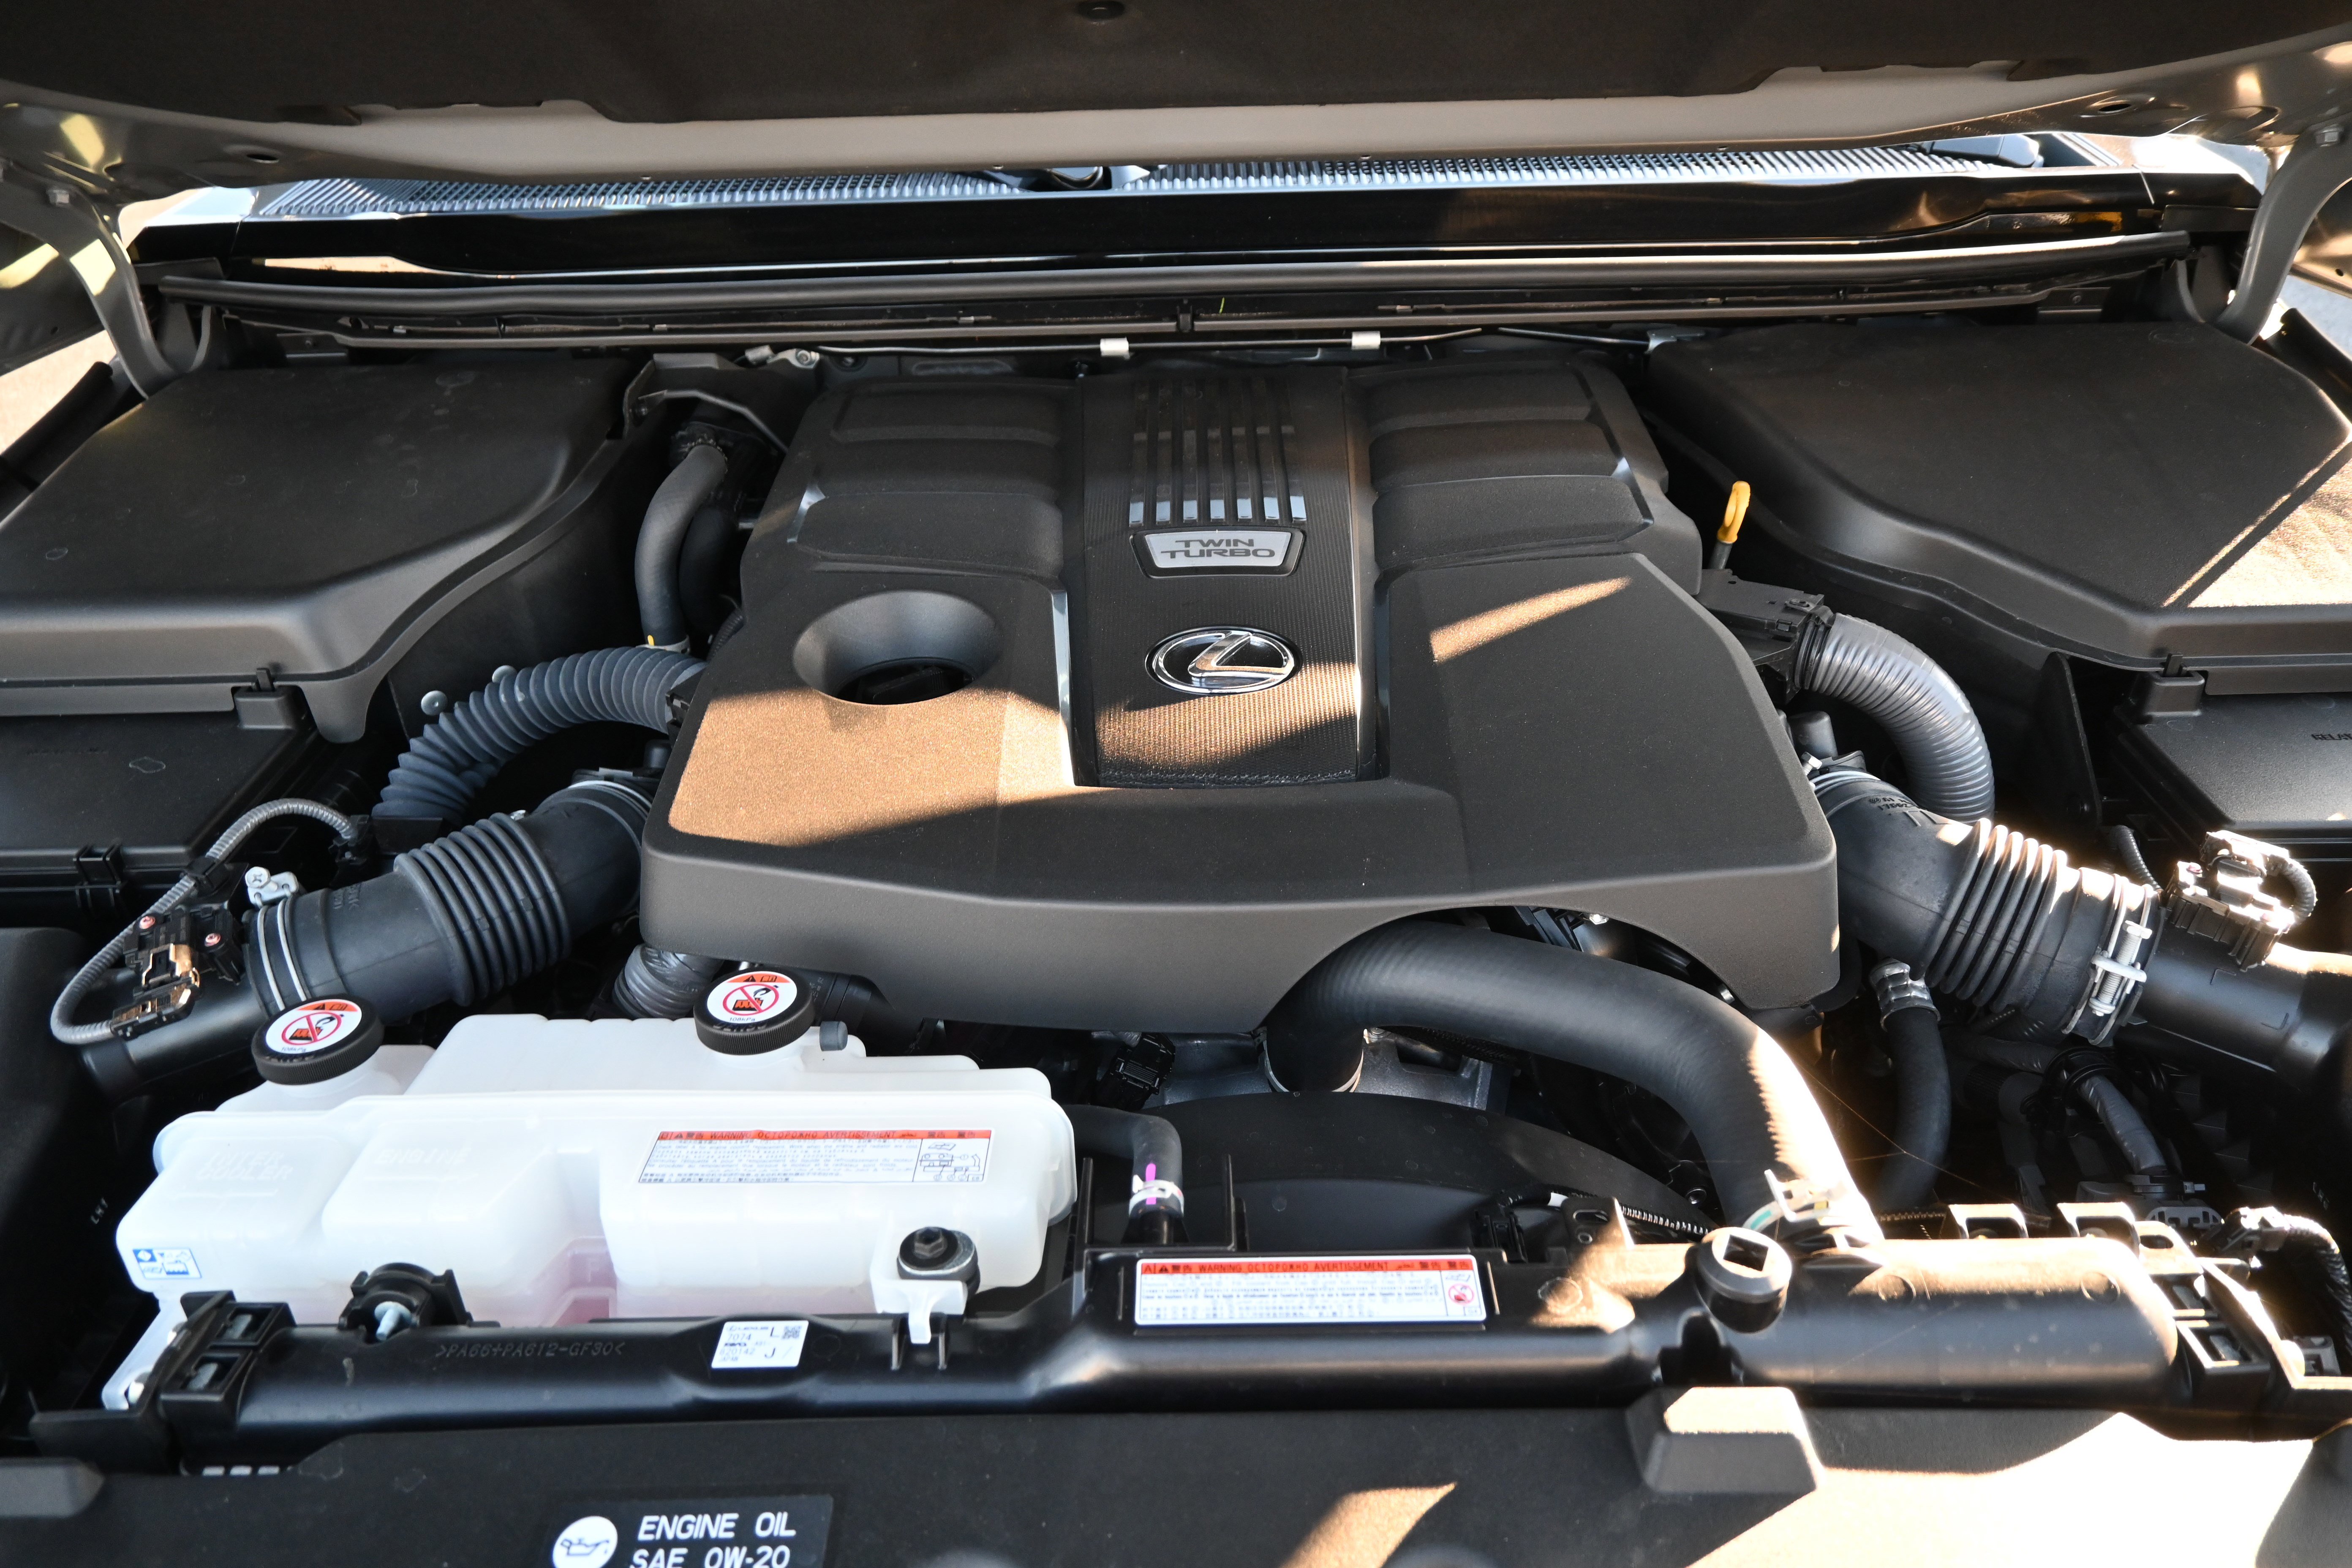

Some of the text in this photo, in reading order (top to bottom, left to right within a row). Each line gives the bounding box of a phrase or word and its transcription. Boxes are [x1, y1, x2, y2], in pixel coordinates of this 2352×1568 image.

[1175, 539, 1254, 548] TWIN
[1160, 548, 1276, 558] TURBO
[204, 1151, 285, 1166] INTER
[374, 1147, 472, 1165] ENGINE
[196, 1164, 294, 1181] COOLER
[1199, 1264, 1242, 1272] WARNING
[1314, 1262, 1388, 1271] AVERTISSEMENT
[765, 1347, 776, 1359] J
[637, 1511, 797, 1541] ENGINE OIL
[629, 1545, 791, 1568] SAE 0W-20
